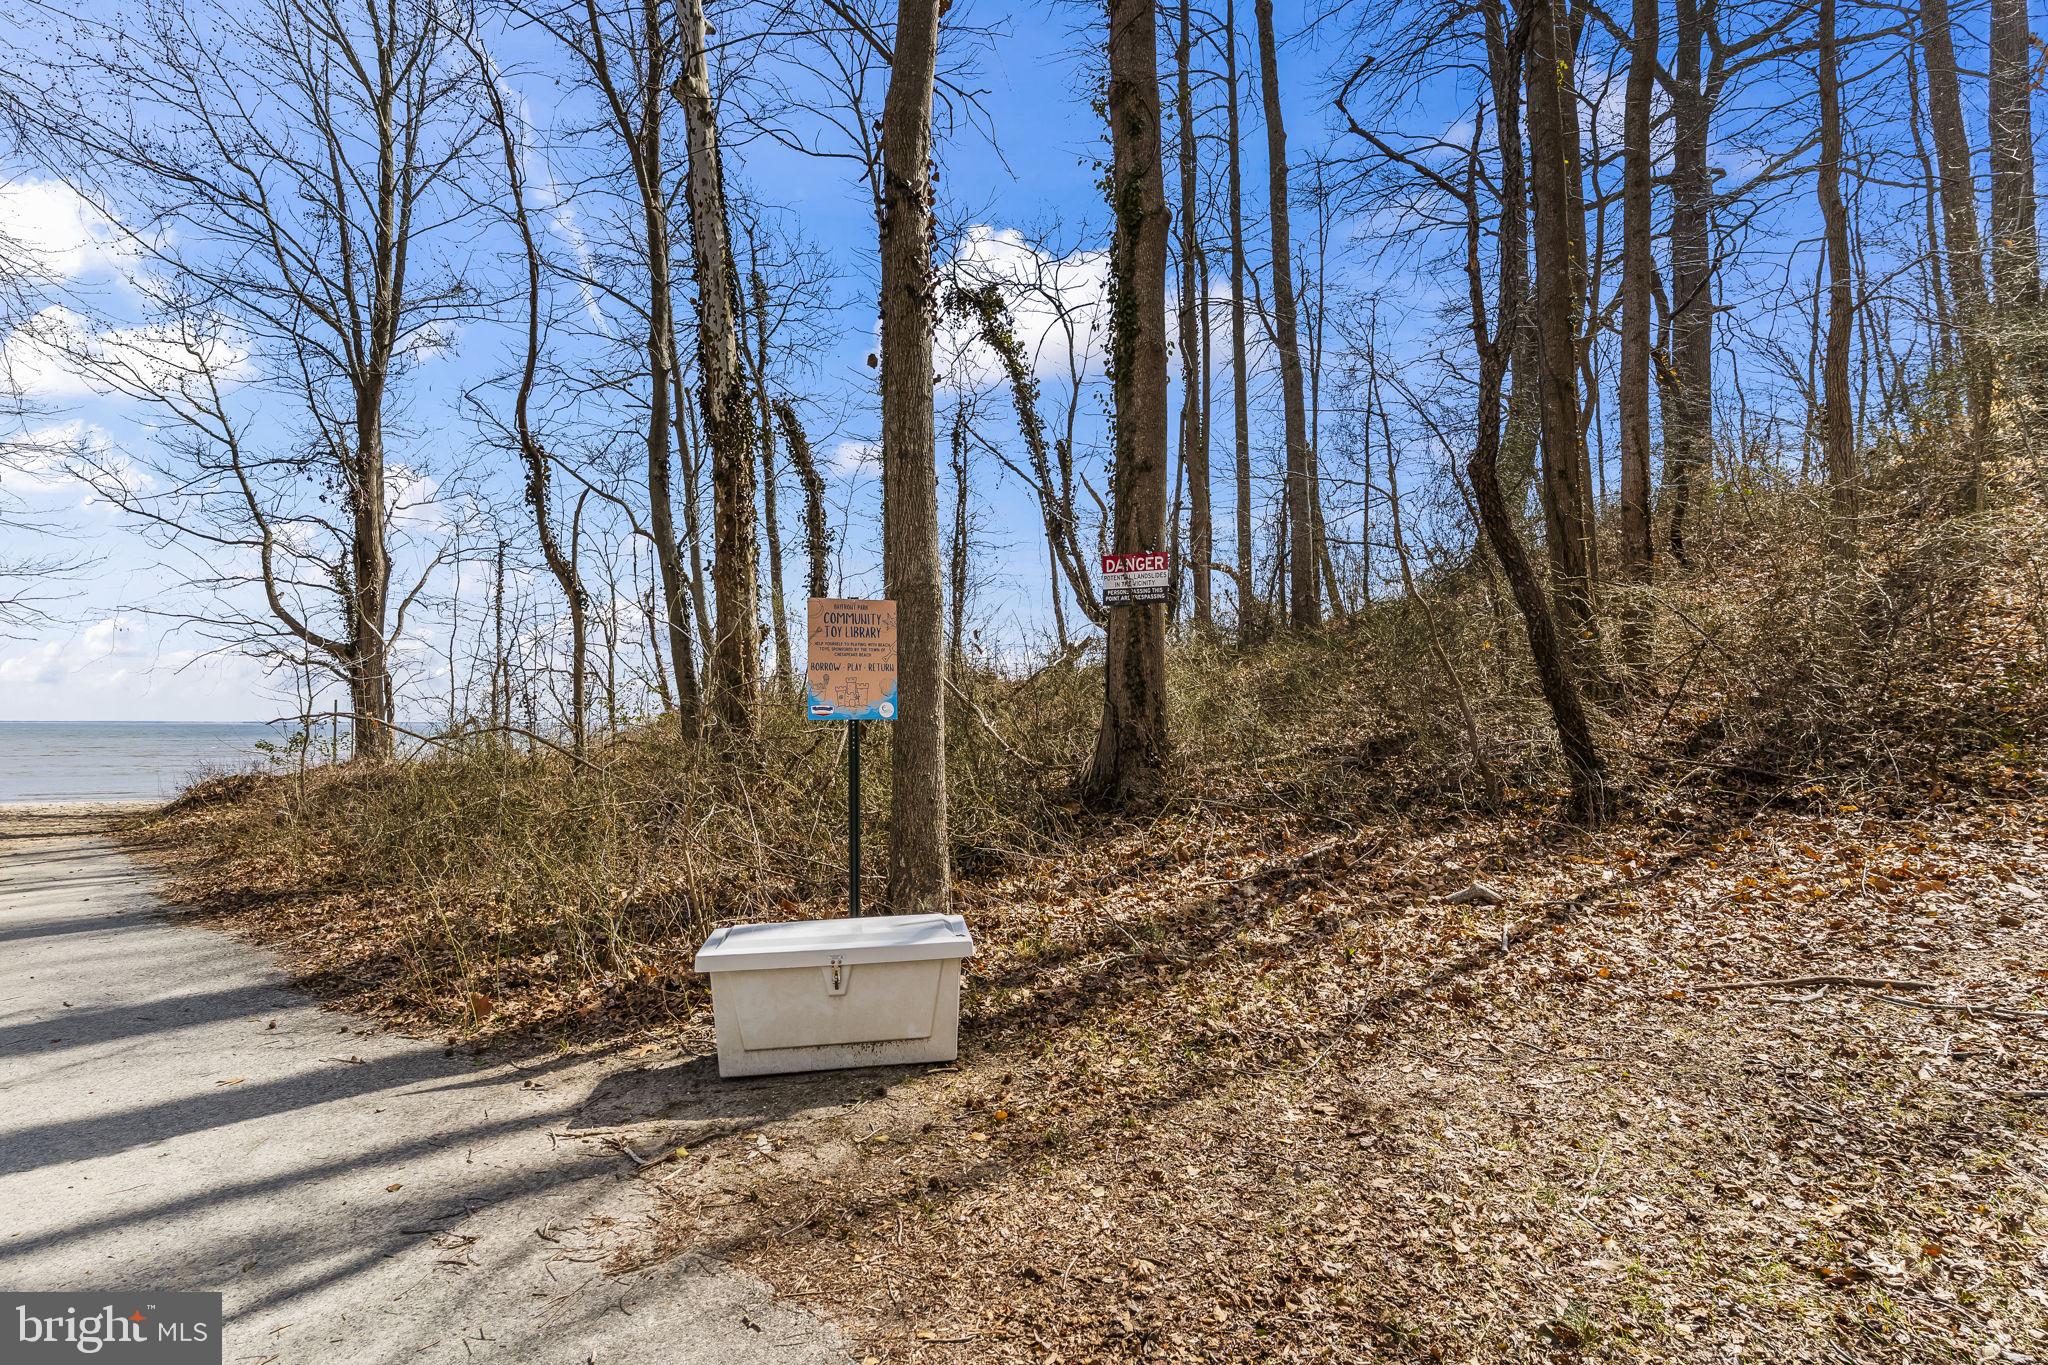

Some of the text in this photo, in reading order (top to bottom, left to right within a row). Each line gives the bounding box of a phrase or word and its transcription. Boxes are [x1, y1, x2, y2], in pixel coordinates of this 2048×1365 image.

[1106, 556, 1164, 573] DANGER
[1134, 572, 1167, 580] LANDSLIDES
[823, 612, 882, 625] COMMUNITY
[824, 625, 882, 639] TOY LIBRARY
[810, 662, 894, 672] BORROW PLAY RETURN
